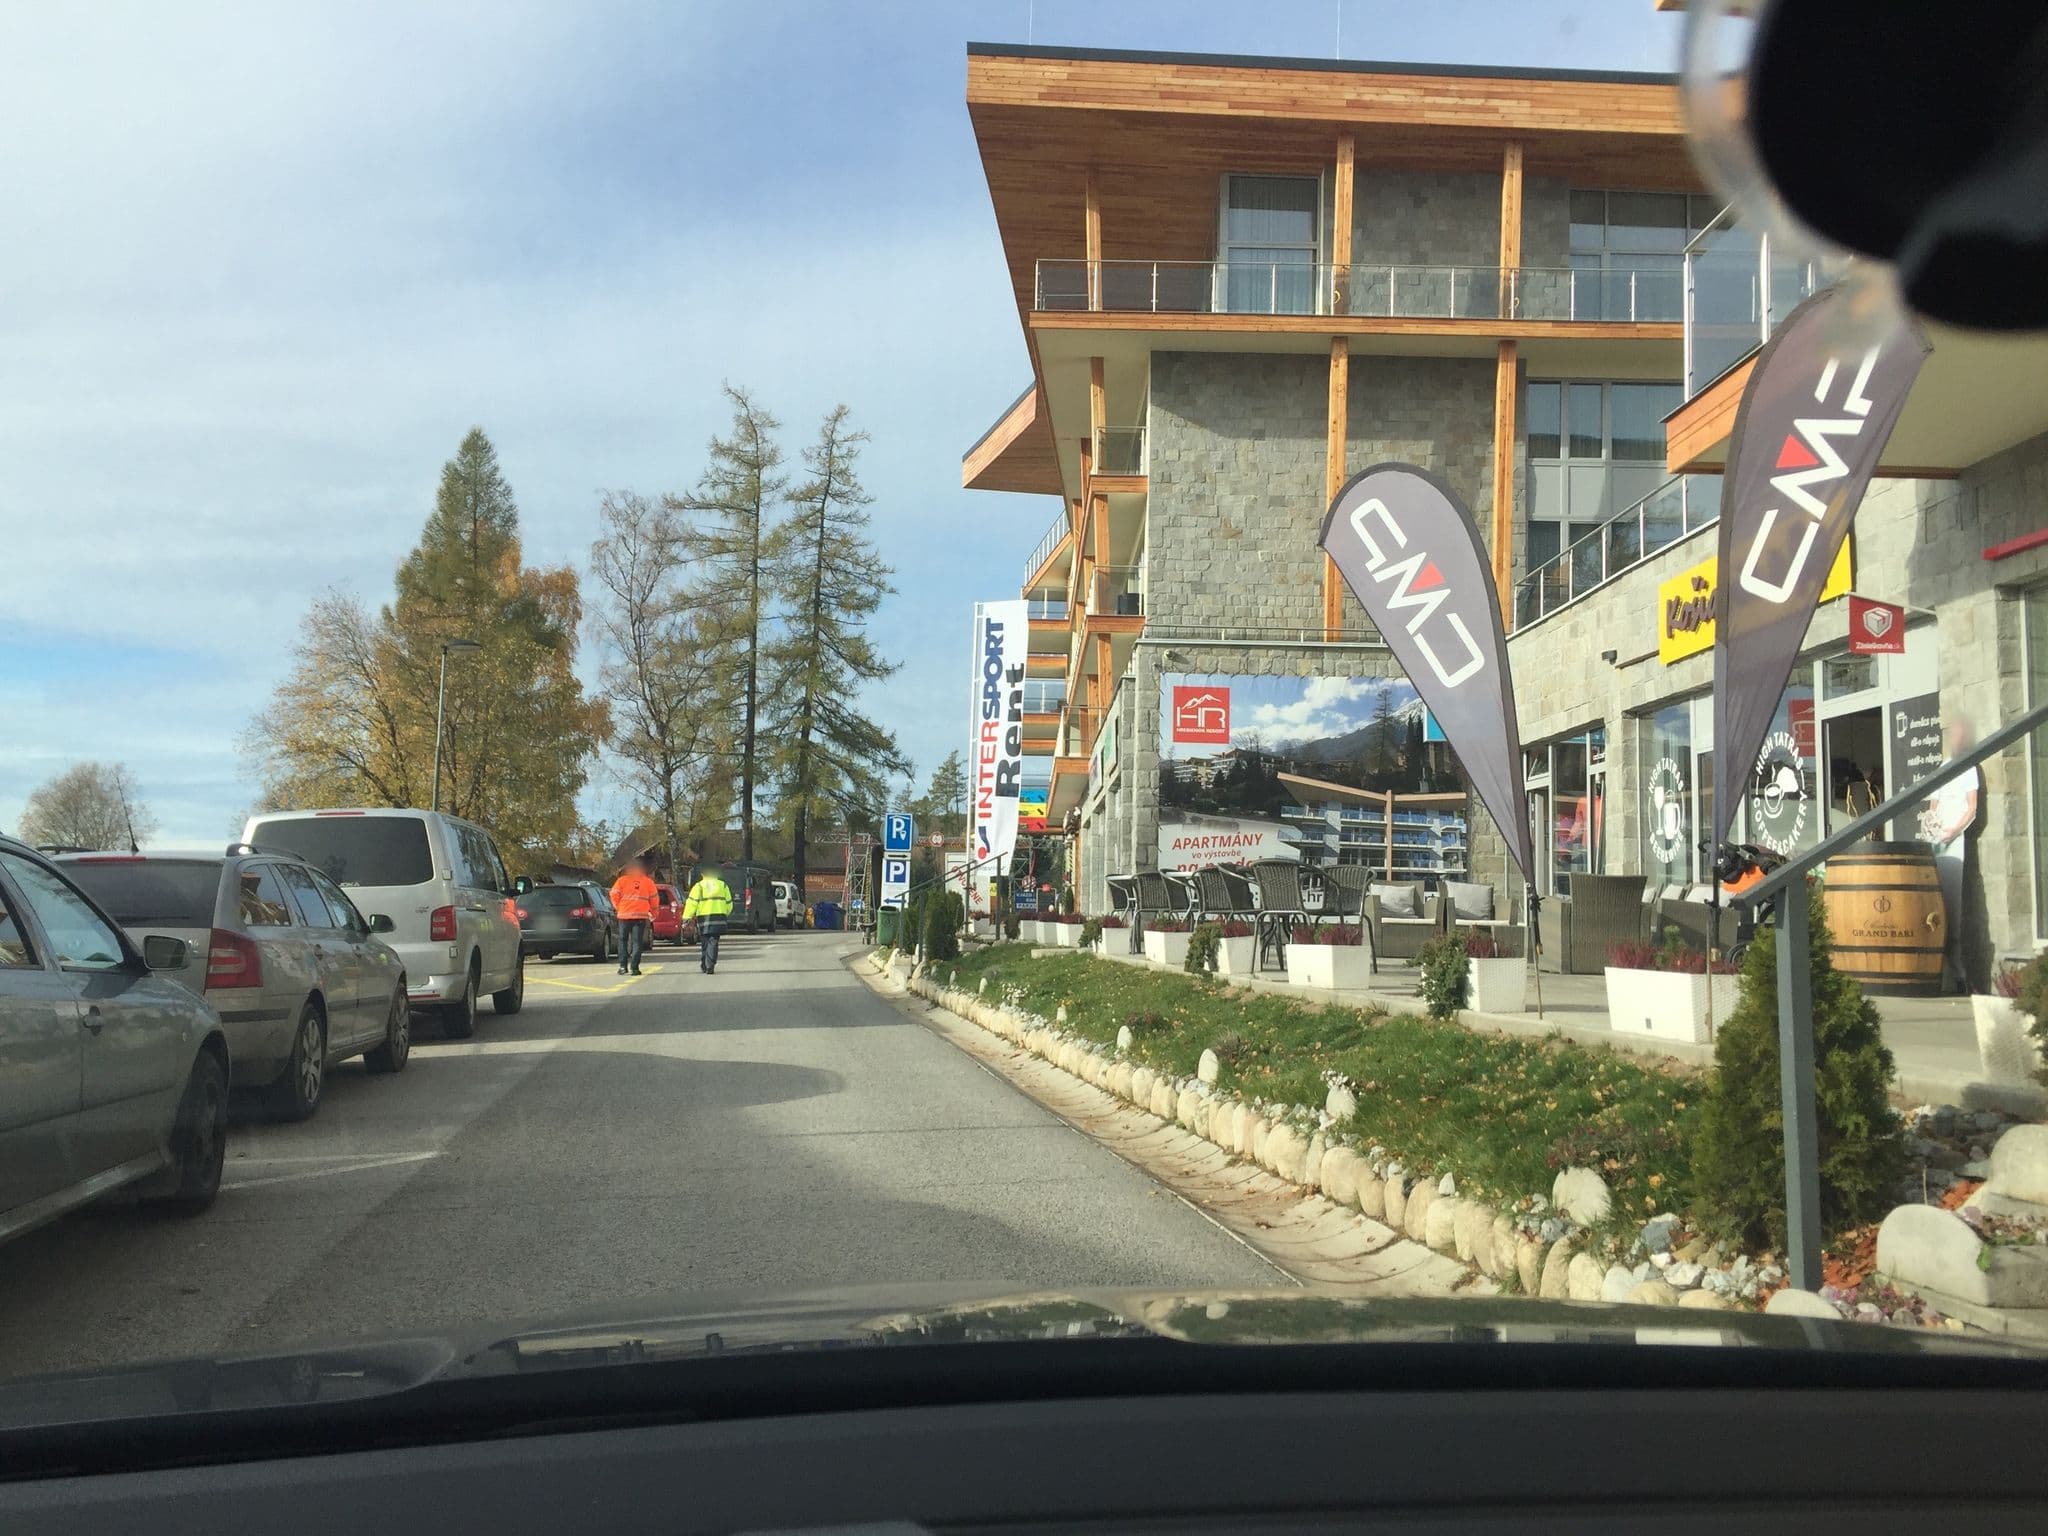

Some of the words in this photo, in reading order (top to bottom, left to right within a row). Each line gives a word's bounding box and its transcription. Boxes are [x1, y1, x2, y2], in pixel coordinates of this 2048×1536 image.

[977, 617, 1004, 818] INTERSPORT
[1176, 706, 1226, 728] HR
[995, 662, 1025, 798] Rent
[1755, 737, 1774, 776] HIGH
[1774, 731, 1804, 770] TATRAS
[1648, 761, 1662, 794] HIGH
[1661, 757, 1684, 792] TATRAS
[892, 818, 906, 839] P
[1172, 831, 1263, 850] APARTMÁNY
[1192, 851, 1202, 859] vo
[1204, 849, 1242, 860] výstavbe
[889, 861, 905, 882] P
[1852, 929, 1888, 937] GRAND
